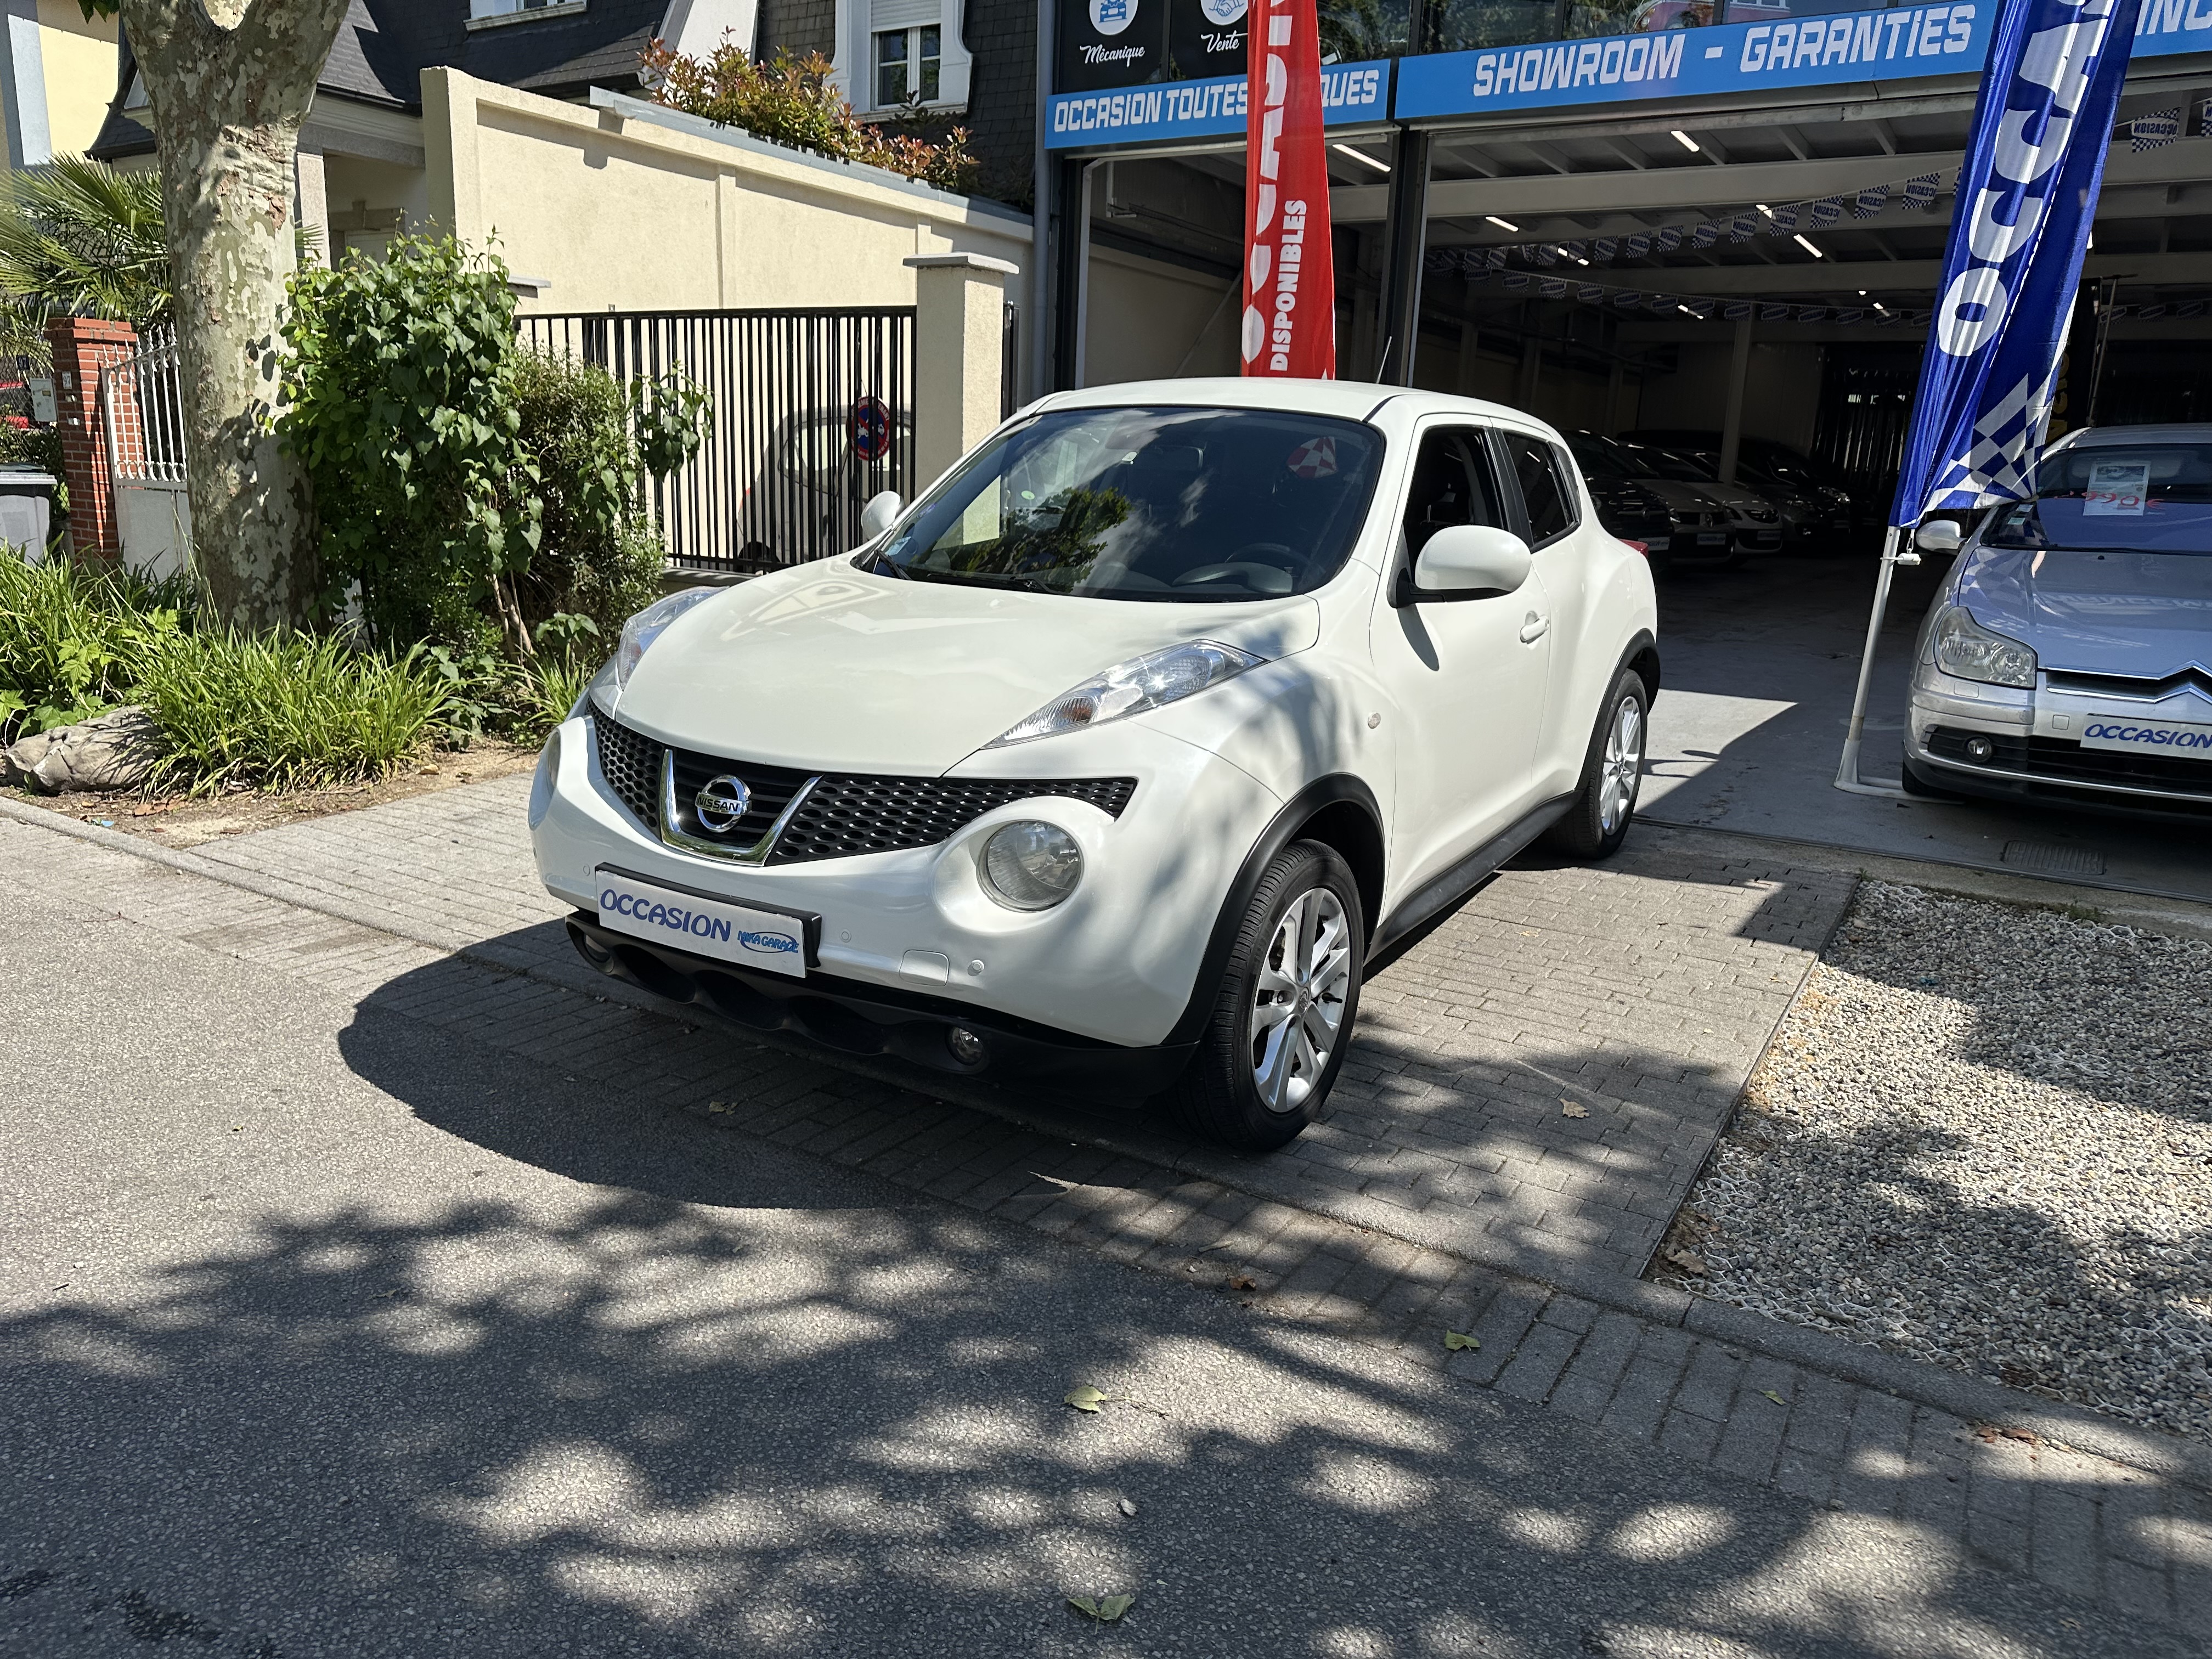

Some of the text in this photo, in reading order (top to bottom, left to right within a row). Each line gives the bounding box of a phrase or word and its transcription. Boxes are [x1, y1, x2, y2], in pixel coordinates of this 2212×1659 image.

[1200, 30, 1248, 53] Vente
[1473, 33, 1686, 97] SHOWROOM
[1740, 4, 1975, 72] GARANTIES
[1054, 91, 1161, 132] OCCASION
[1166, 82, 1248, 122] TOUTES
[1269, 200, 1307, 371] DISPONIBLES
[18, 356, 28, 368] 97
[63, 376, 70, 386] 97
[2085, 724, 2212, 749] OCCASION
[697, 797, 740, 812] NISSAN
[600, 889, 731, 941] OCCASION
[737, 930, 799, 953] MIKA GARAGE
